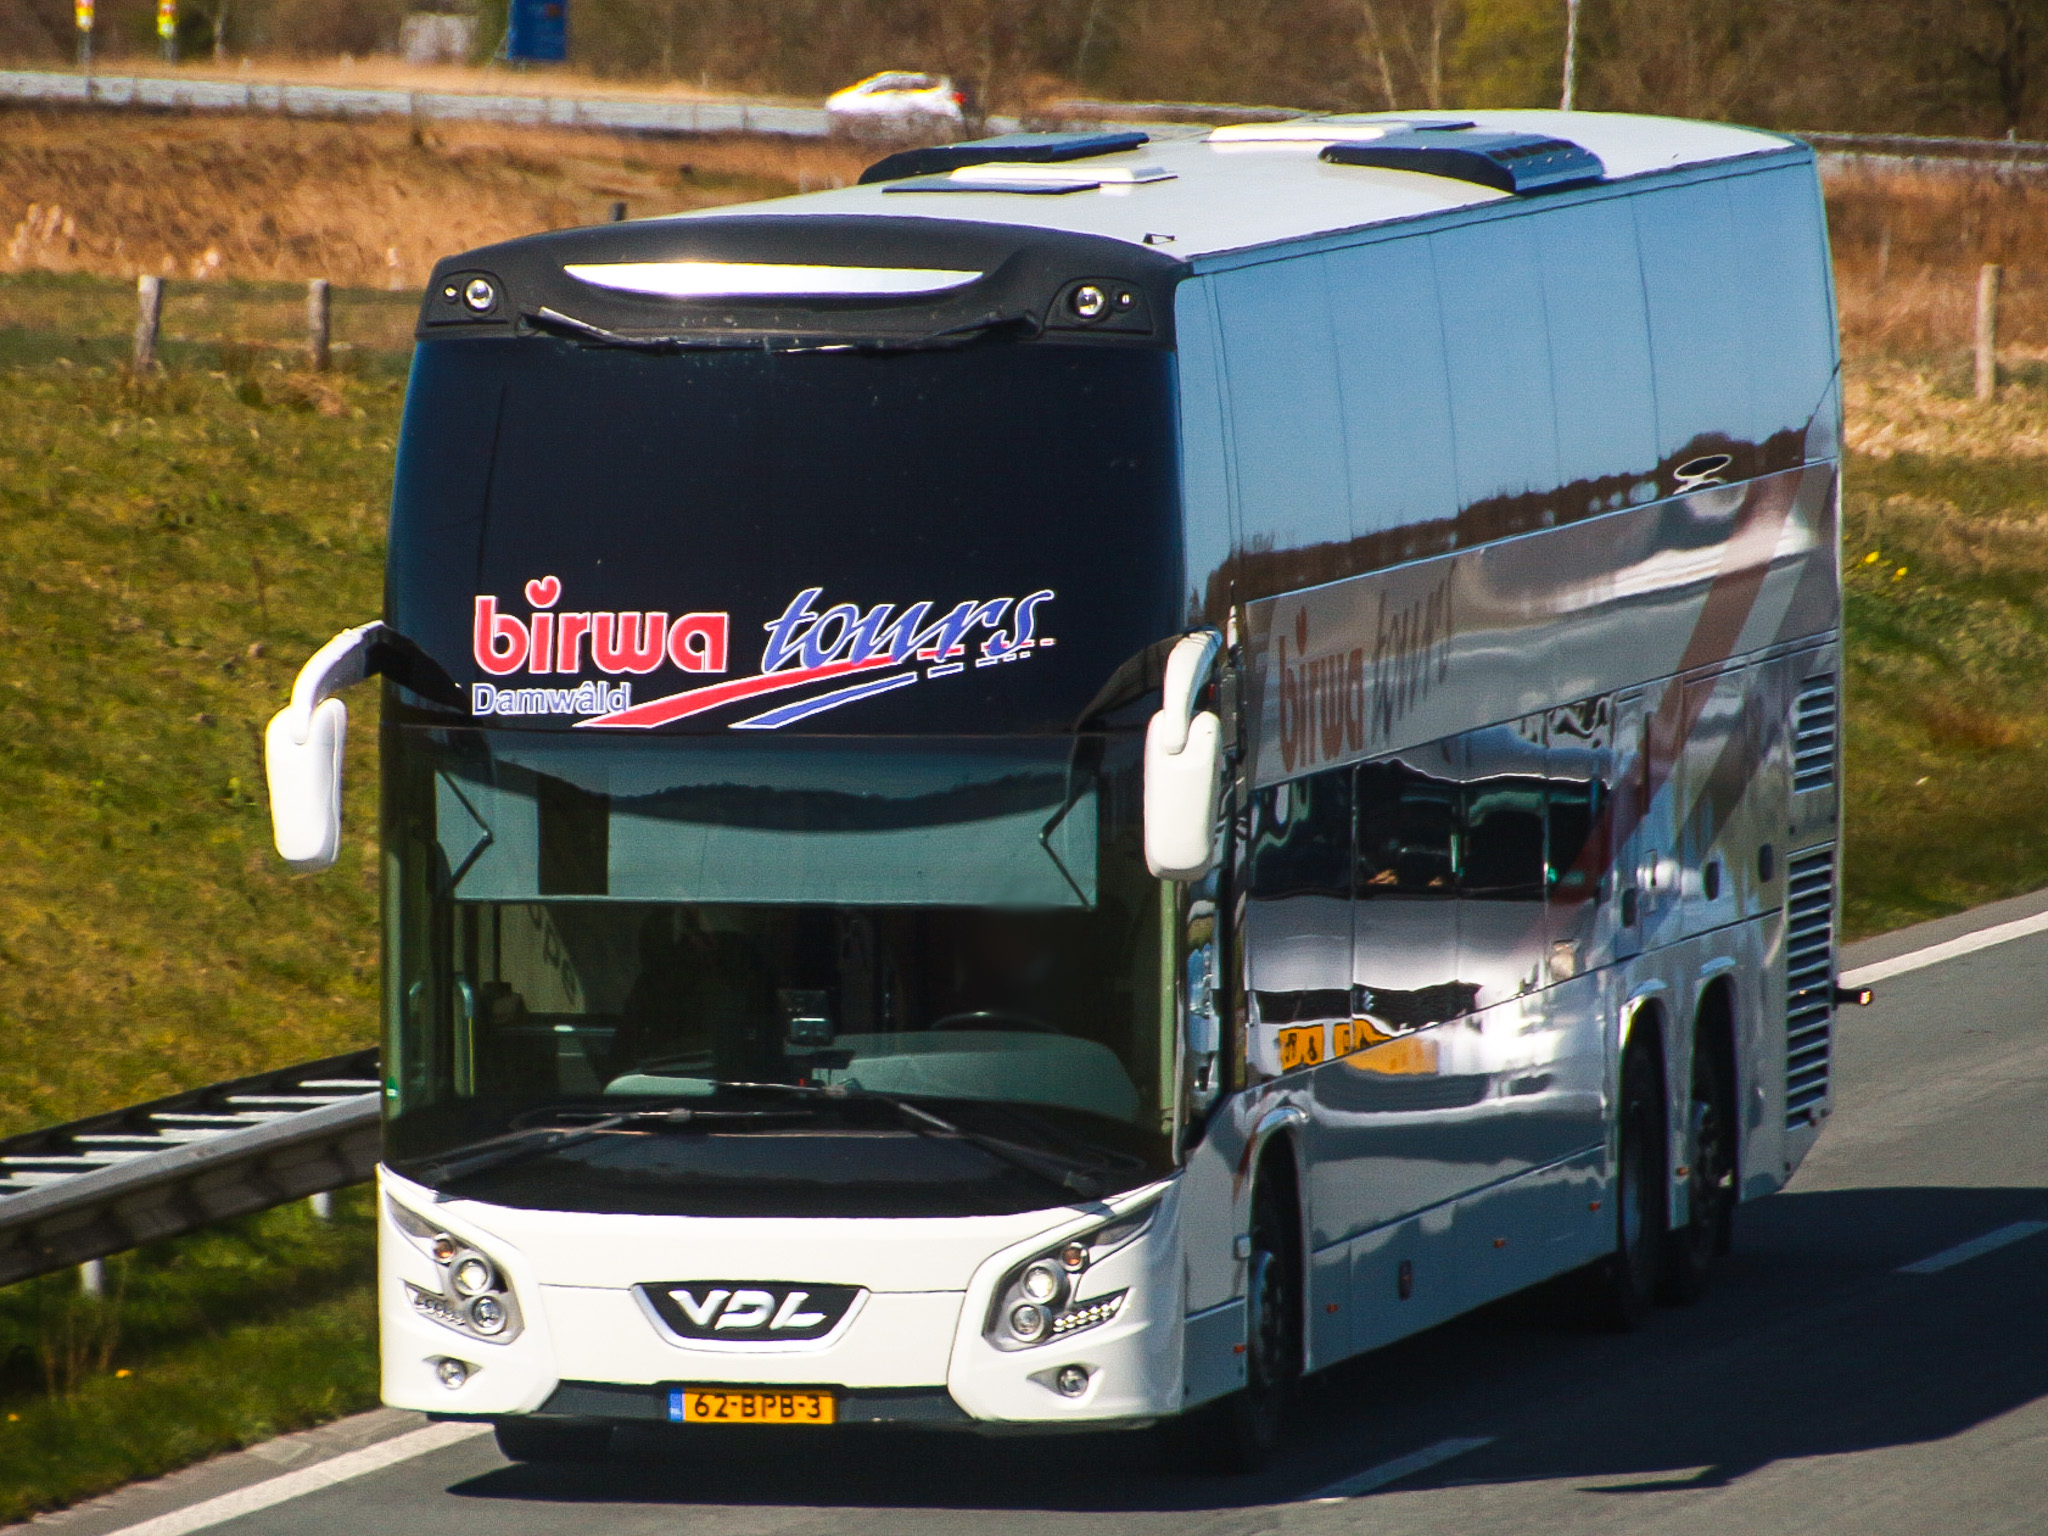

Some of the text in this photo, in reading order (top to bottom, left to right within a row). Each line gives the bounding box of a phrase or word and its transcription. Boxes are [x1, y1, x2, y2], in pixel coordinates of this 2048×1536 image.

[474, 576, 1055, 675] birwa tours
[472, 682, 632, 716] Damwâld
[1278, 605, 1364, 773] birwa
[667, 1289, 827, 1331] VDL
[693, 1392, 822, 1419] 62-BPB-3
